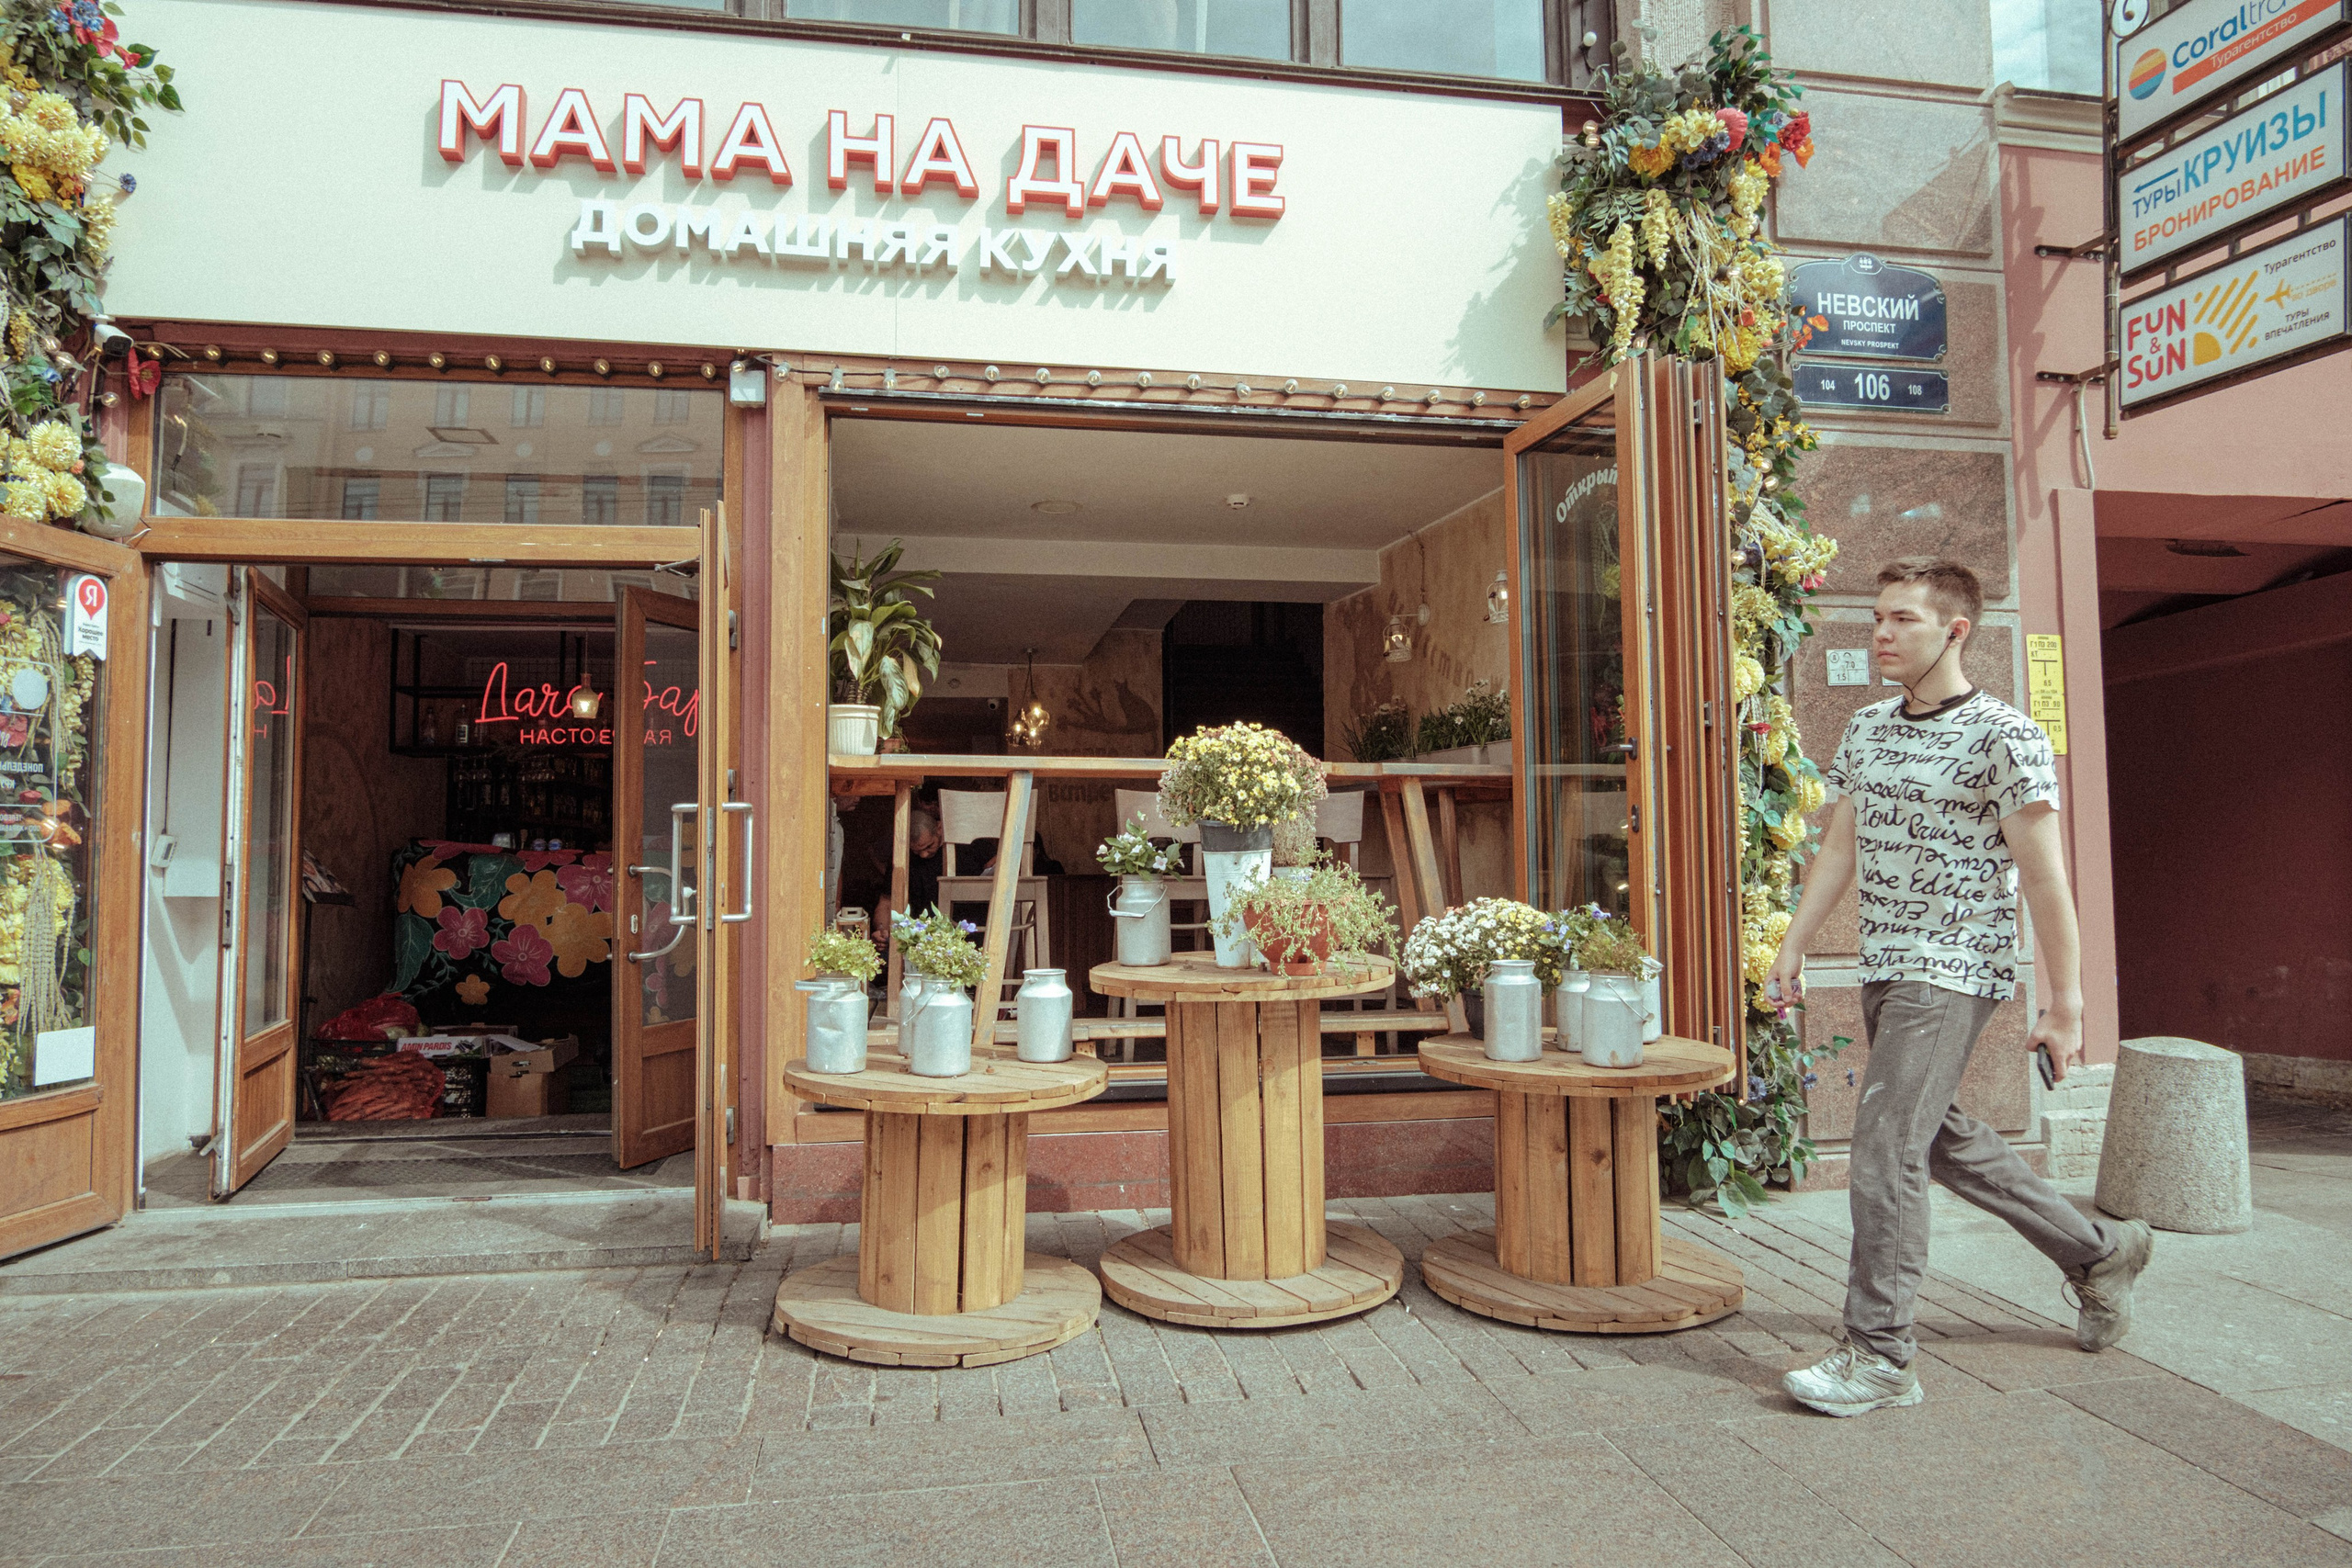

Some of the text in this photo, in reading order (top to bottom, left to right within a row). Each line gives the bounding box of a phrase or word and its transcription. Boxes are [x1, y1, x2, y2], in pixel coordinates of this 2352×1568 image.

[2211, 13, 2297, 69] Турагентство
[438, 79, 1286, 220] МАМА НА ДАЧЕ
[2132, 91, 2326, 219] ТУРЫ КРУИЗЫ
[2134, 144, 2326, 252] БРОНИРОВАНИЕ
[571, 199, 1179, 287] ДОМАШНЯЯ КУХНЯ
[2264, 240, 2336, 275] Турагентство
[1817, 292, 1919, 321] НЕВСКИЙ
[2285, 309, 2310, 322] ТУРЫ
[1843, 320, 1896, 333] ПРОСПЕКТ
[2265, 312, 2330, 341] ВПЕЧАТЛЕНИЯ
[1841, 339, 1899, 349] NEVSKY PROSPEKT
[2150, 336, 2161, 355] &
[1821, 372, 1922, 400] 104 106 108
[423, 1042, 452, 1051] PARDIS
